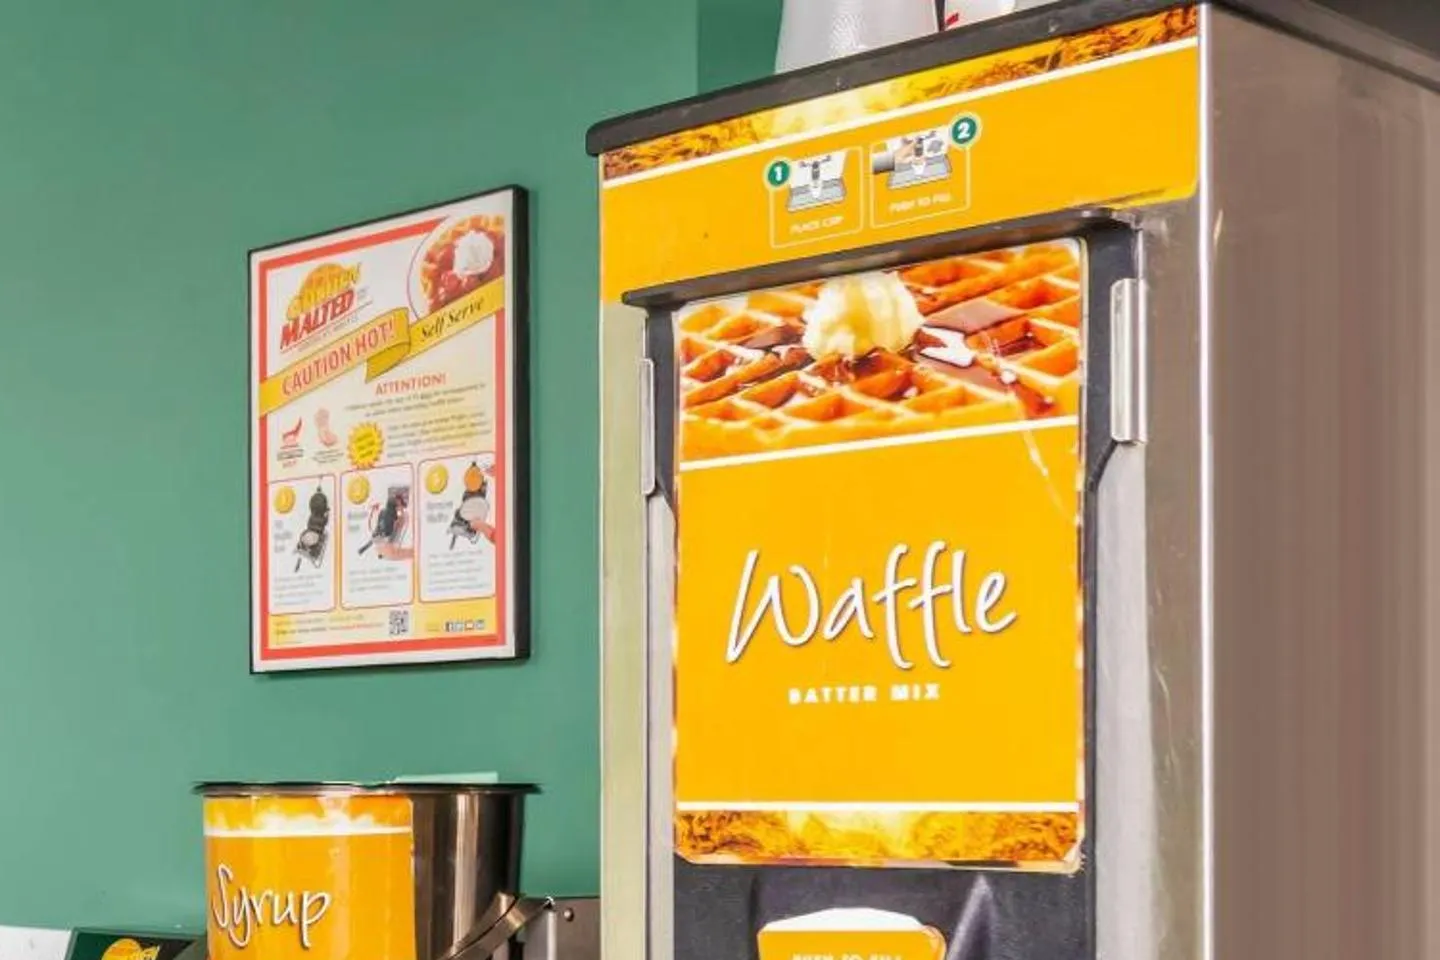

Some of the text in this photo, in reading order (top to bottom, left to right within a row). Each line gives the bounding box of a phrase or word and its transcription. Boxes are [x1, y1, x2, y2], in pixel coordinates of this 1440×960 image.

[956, 122, 971, 140] 2
[773, 167, 784, 182] 1
[280, 288, 355, 350] MALTED
[419, 296, 485, 342] Self Serve
[281, 342, 351, 397] CAUTION
[355, 318, 395, 357] HOT!
[375, 373, 447, 396] ATTENTION!
[724, 539, 1018, 671] Waffle
[788, 682, 941, 705] BATTER MIX
[211, 864, 332, 953] Syrup
